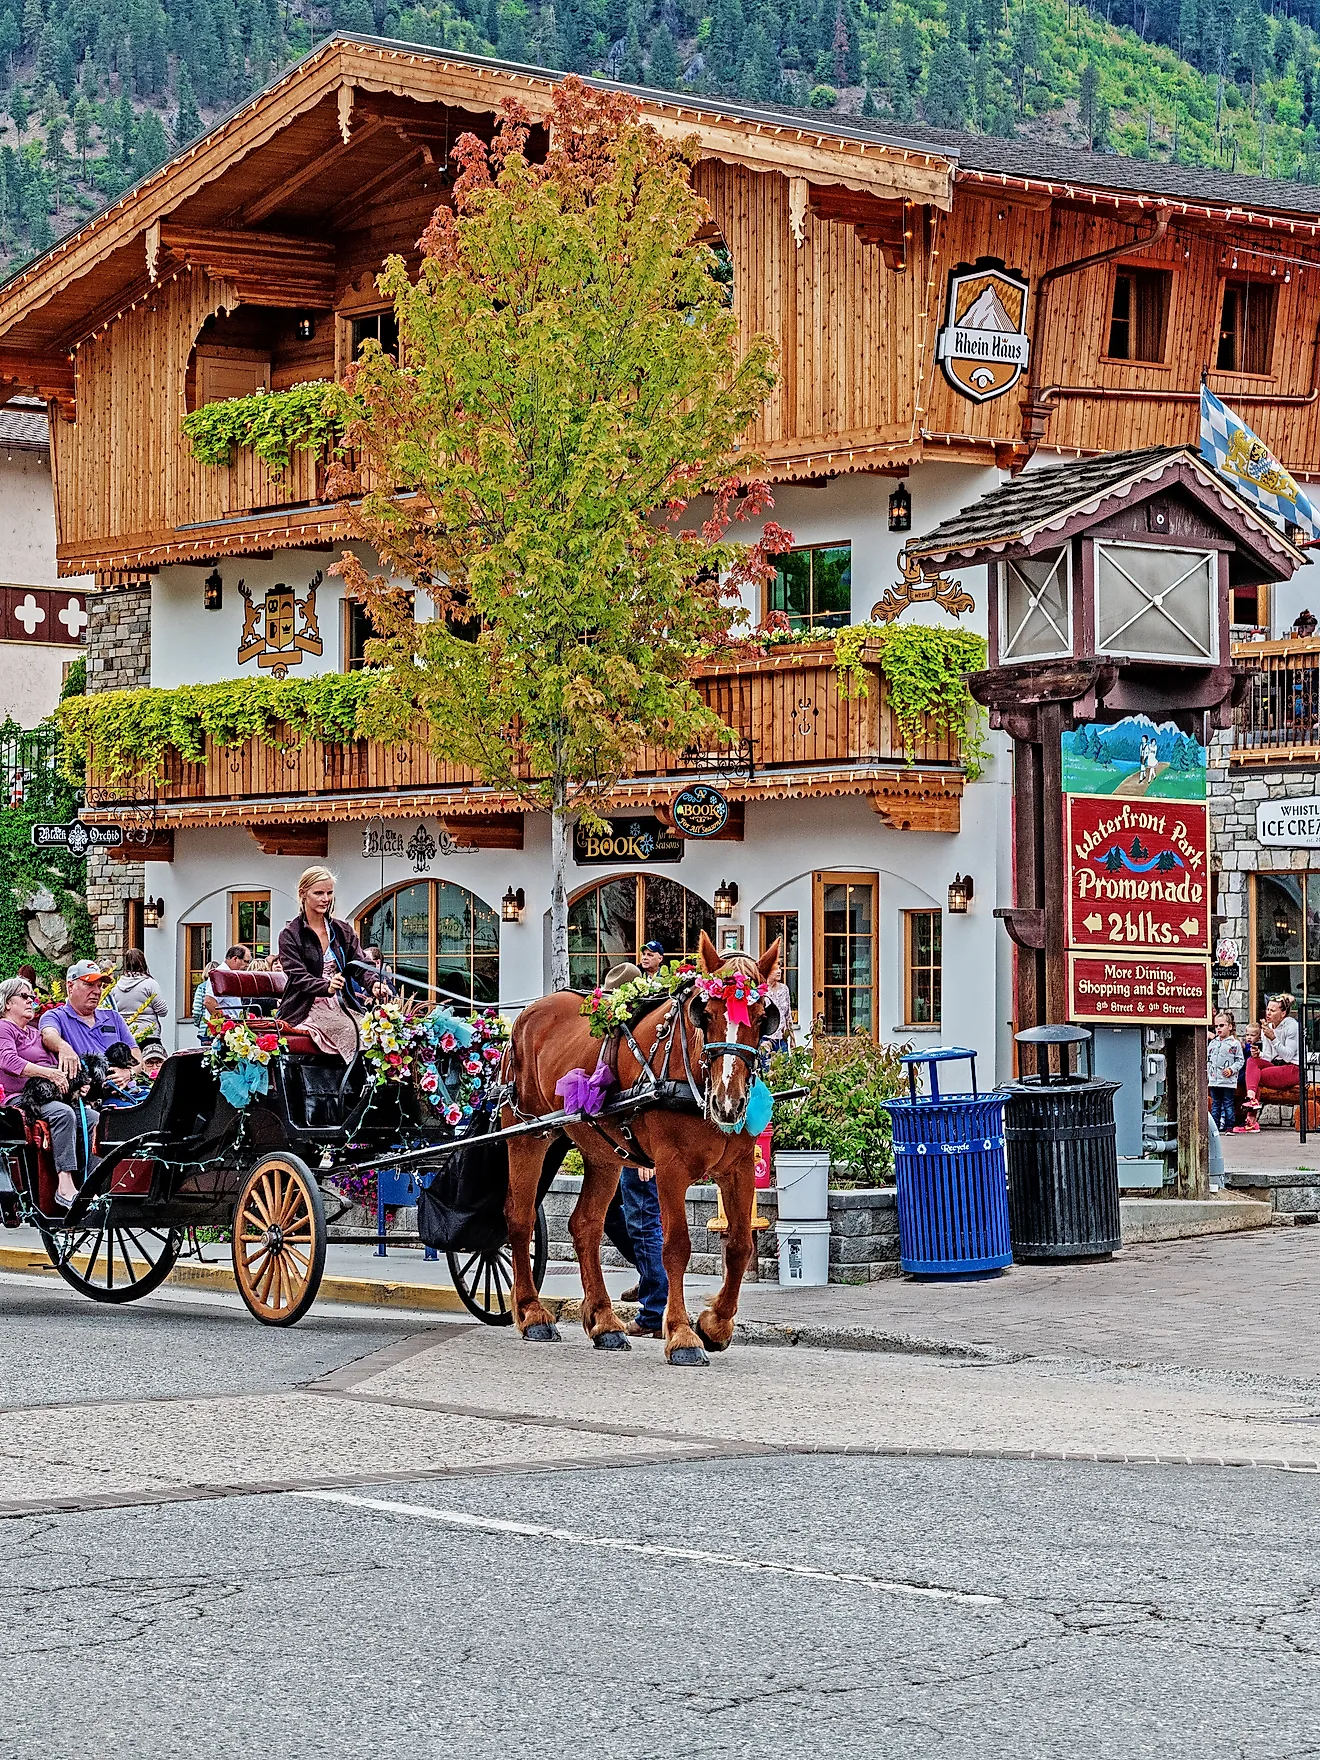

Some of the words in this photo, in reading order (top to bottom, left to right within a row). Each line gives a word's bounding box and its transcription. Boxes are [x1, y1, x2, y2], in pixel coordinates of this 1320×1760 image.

[955, 332, 988, 356] Rhein
[696, 790, 706, 799] A
[683, 804, 723, 819] BOOK
[1280, 804, 1320, 816] WHISTL
[38, 826, 67, 843] Black
[89, 826, 120, 844] Orchid
[386, 830, 397, 840] The
[1262, 820, 1285, 837] ICE
[361, 830, 404, 858] Black
[655, 840, 680, 851] seasons
[1075, 804, 1167, 860] Waterfront
[1170, 820, 1205, 872] Park
[584, 835, 650, 859] BOOK
[1074, 867, 1203, 904] Promenade
[1104, 964, 1133, 980] More
[1135, 965, 1177, 983] Dining,
[1078, 979, 1131, 998] Shopping
[1133, 981, 1154, 996] and
[1156, 981, 1203, 997] Services
[1096, 1001, 1109, 1012] 8th
[1110, 1001, 1134, 1013] Street
[1136, 1001, 1145, 1012] &
[1148, 1002, 1160, 1013] 9th
[1162, 1003, 1186, 1014] Street
[940, 1142, 970, 1155] Recycle
